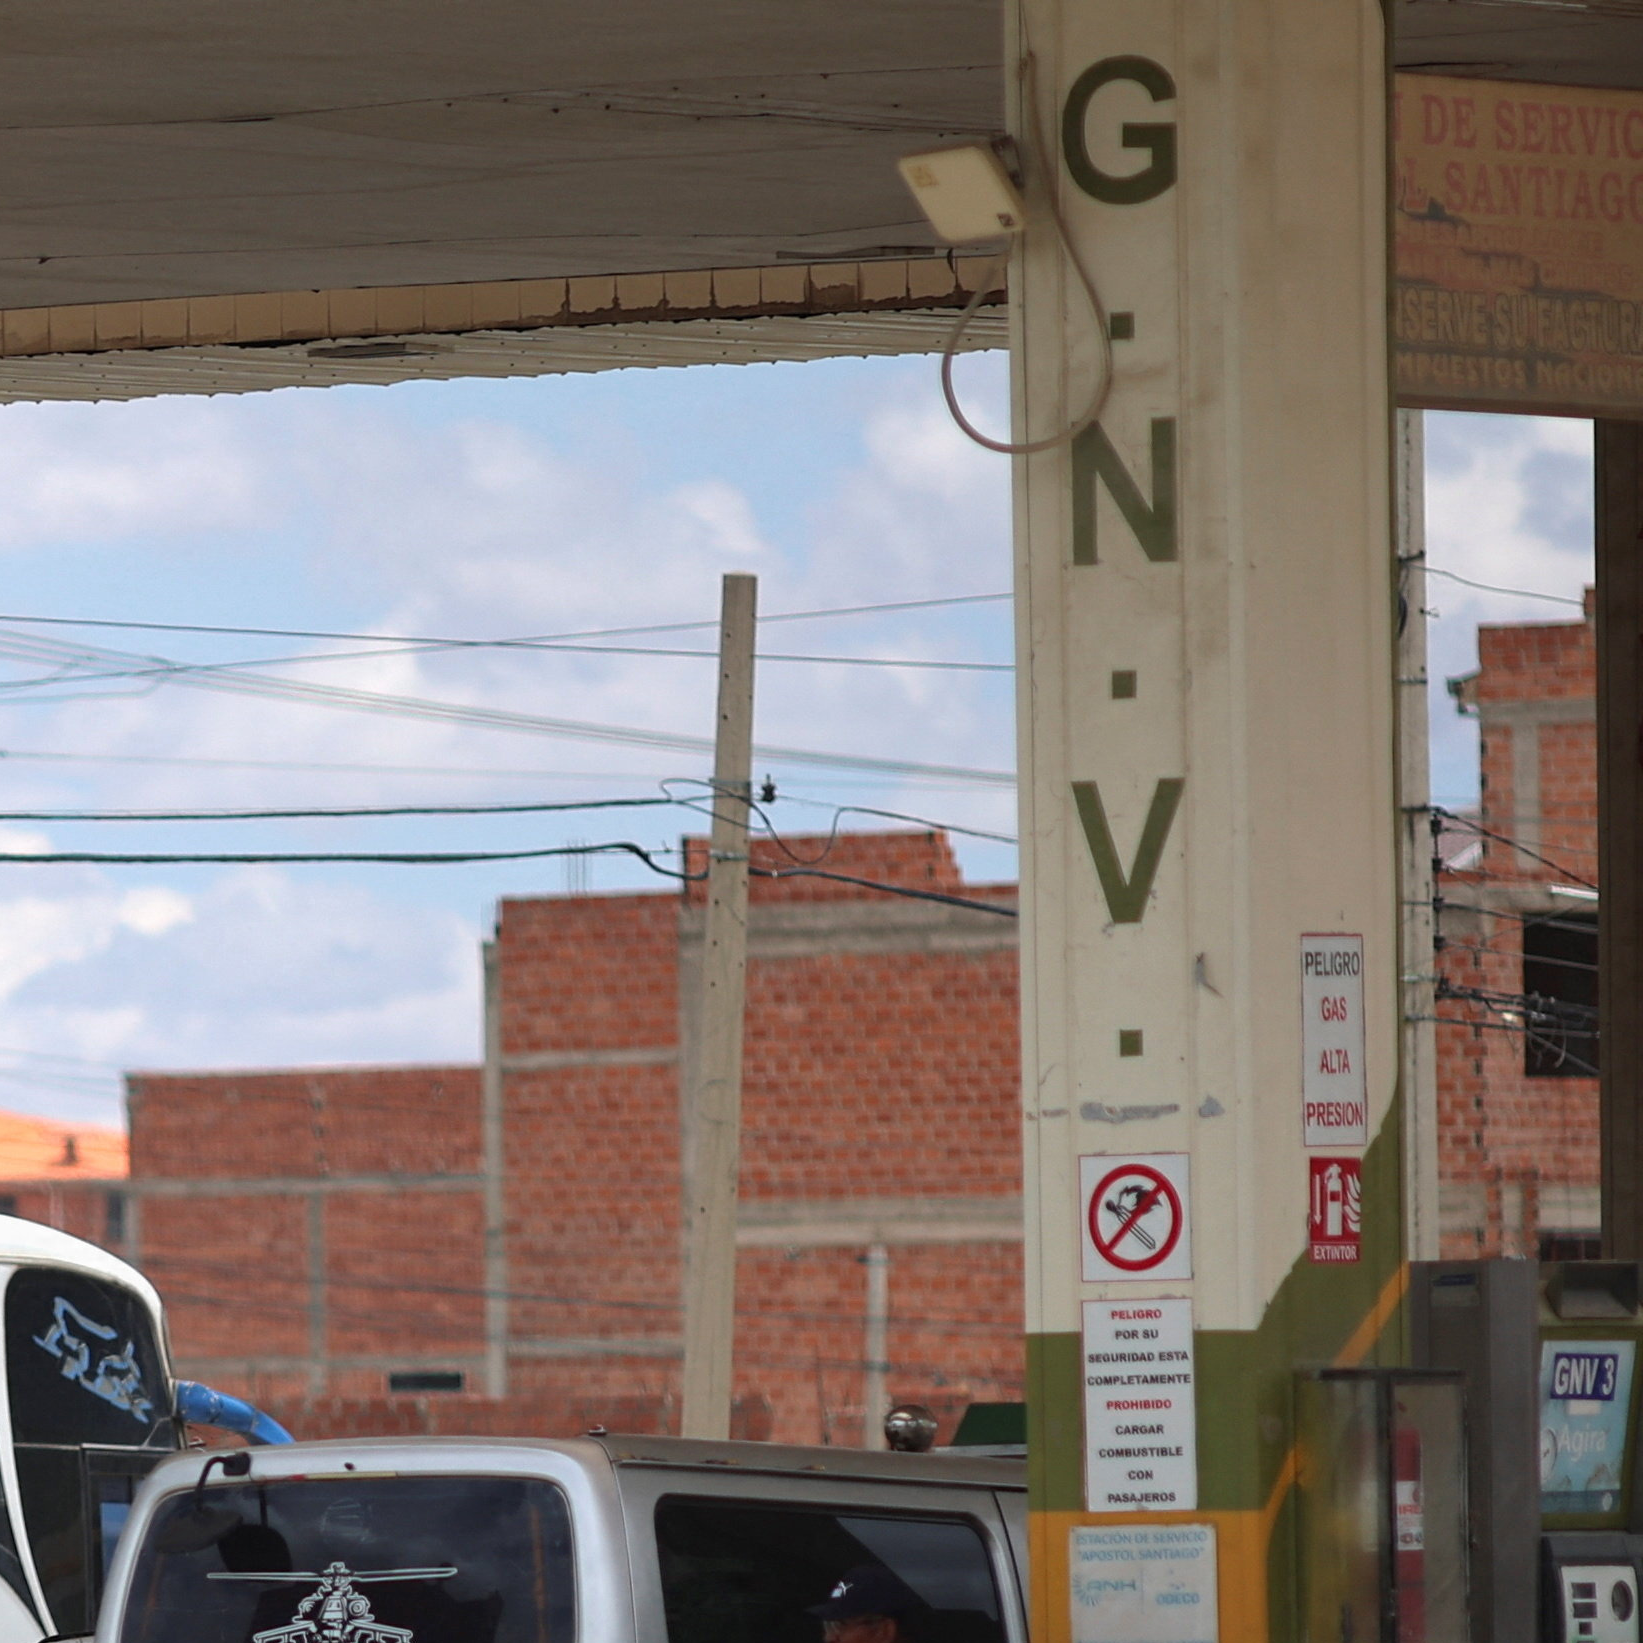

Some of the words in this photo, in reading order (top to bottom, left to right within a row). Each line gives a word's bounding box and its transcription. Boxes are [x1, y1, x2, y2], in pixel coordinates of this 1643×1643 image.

[1421, 94, 1477, 148] DE
[1305, 951, 1360, 976] PELIGRO
[1321, 996, 1347, 1021] GAS
[1320, 1048, 1351, 1074] ALTA
[1306, 1101, 1363, 1127] PRESION
[1314, 1245, 1357, 1260] EXTINTOR
[1111, 1309, 1162, 1320] PELIGRO
[1115, 1330, 1139, 1340] POR
[1142, 1329, 1159, 1339] SU
[1088, 1352, 1155, 1363] SEGURIDAD
[1159, 1351, 1189, 1361] ESTA
[1087, 1373, 1192, 1386] COMPLETAMENTE
[1555, 1357, 1599, 1395] GNV
[1601, 1357, 1615, 1396] 3
[1106, 1399, 1172, 1410] PROHIBIDO
[1115, 1424, 1164, 1435] CARGAR
[1098, 1446, 1183, 1458] COMBUSTIBLE
[1128, 1470, 1154, 1480] CON
[1107, 1492, 1176, 1503] PASAJEROS
